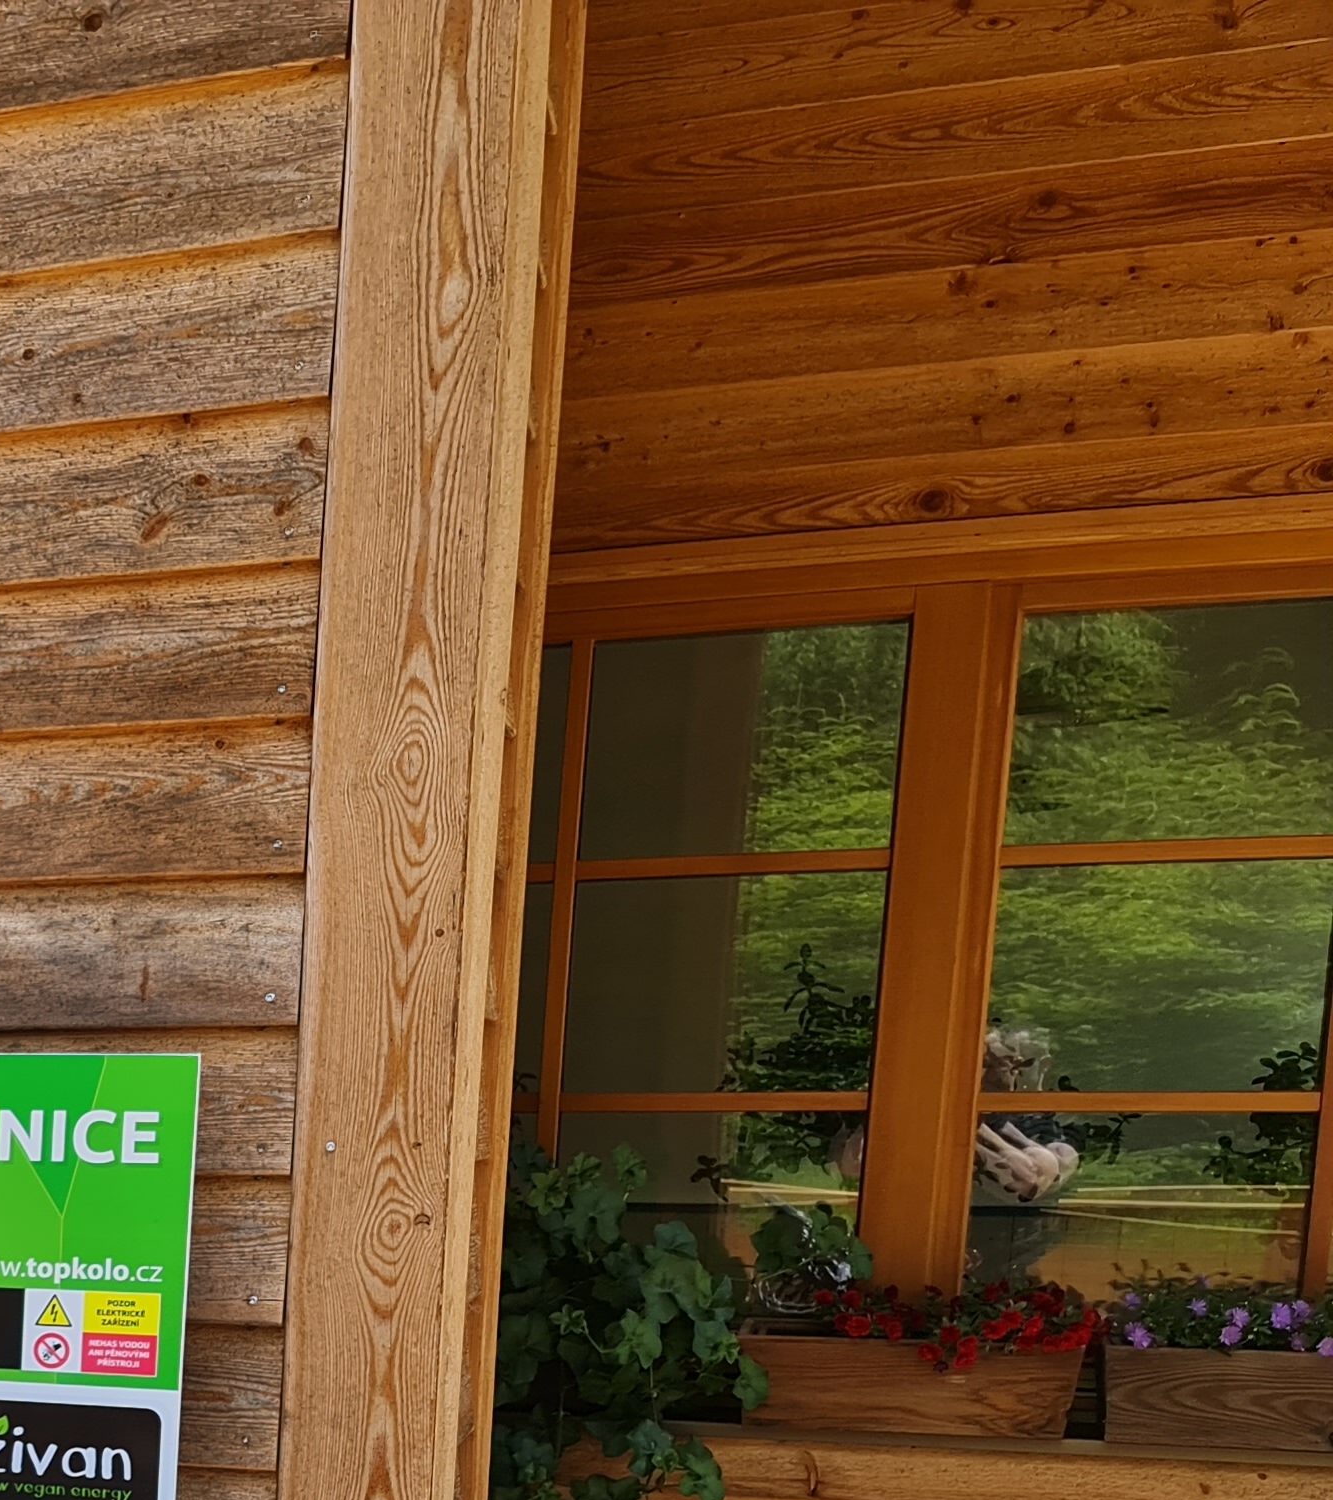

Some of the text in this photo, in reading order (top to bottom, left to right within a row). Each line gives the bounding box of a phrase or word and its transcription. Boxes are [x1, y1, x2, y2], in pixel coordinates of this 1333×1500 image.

[107, 1299, 136, 1308] POZOR
[96, 1308, 146, 1318] ELEKTRICKÉ
[14, 1481, 66, 1500] vegan
